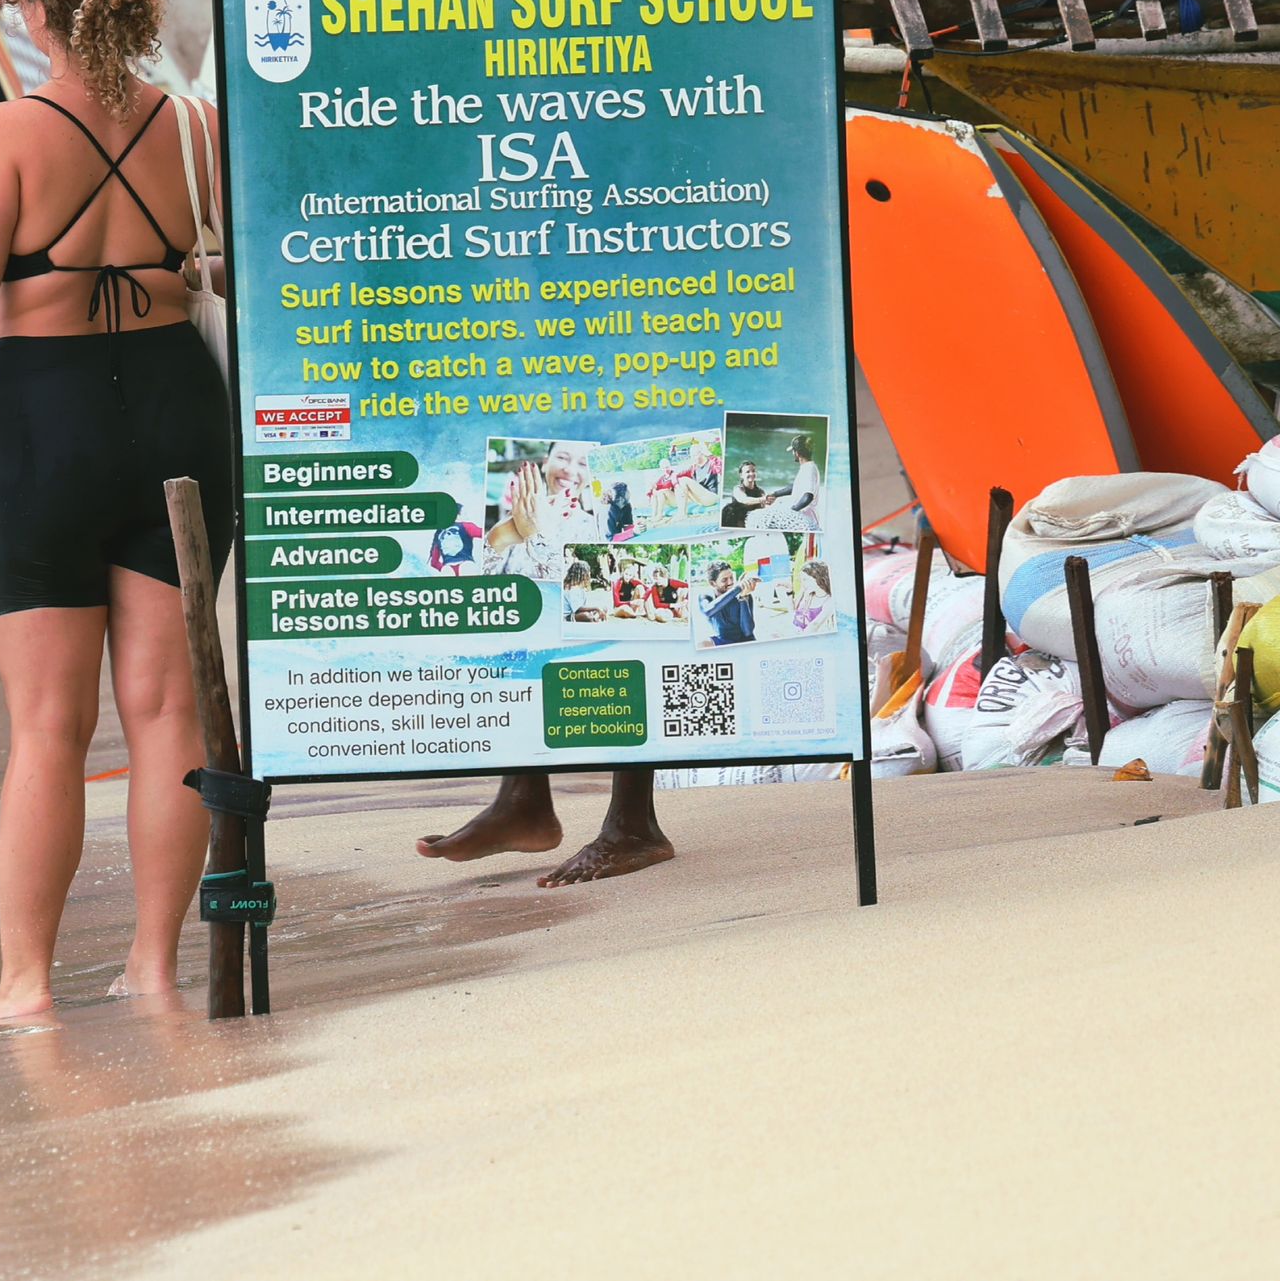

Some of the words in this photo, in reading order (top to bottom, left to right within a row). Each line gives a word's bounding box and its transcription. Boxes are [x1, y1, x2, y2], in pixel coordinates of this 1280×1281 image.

[261, 55, 298, 63] HIRIKETIYA
[484, 34, 652, 77] HIRIKETIYA
[298, 86, 397, 128] Ride
[410, 84, 483, 126] the
[496, 88, 646, 123] waves
[659, 74, 764, 117] with
[477, 130, 590, 183] ISA
[300, 185, 482, 221] (International
[490, 183, 593, 215] Surfing
[601, 177, 769, 207] Association)
[281, 223, 453, 264] Certified
[464, 220, 555, 259] Surf
[565, 218, 791, 255] Instructors
[281, 282, 341, 310] Surf
[350, 282, 463, 307] lessons
[470, 277, 530, 304] with
[540, 270, 717, 307] experienced
[727, 267, 795, 295] local
[295, 319, 352, 346] surf
[361, 317, 525, 344] instructors.
[534, 317, 576, 339] we
[584, 310, 633, 337] will
[641, 307, 721, 335] teach
[729, 310, 783, 338] you
[302, 357, 363, 383] how
[370, 357, 401, 382] to
[407, 352, 487, 380] catch
[495, 356, 513, 377] a
[521, 353, 604, 377] wave,
[614, 349, 716, 379] pop-up
[725, 342, 779, 369] and
[359, 390, 416, 418] ride
[423, 390, 470, 416] the
[478, 392, 552, 415] wave
[562, 386, 588, 412] in
[596, 387, 625, 411] to
[634, 384, 724, 410] shore.
[261, 412, 285, 422] WE
[288, 410, 342, 422] ACCEPT
[264, 462, 393, 487] Beginners
[266, 504, 425, 526] Intermediate
[270, 545, 379, 566] Advance
[271, 588, 359, 610] Private
[366, 587, 464, 607] lessons
[471, 582, 517, 604] and
[271, 612, 370, 632] lessons
[376, 609, 412, 629] for
[418, 607, 459, 628] the
[467, 605, 520, 626] kids
[288, 669, 303, 685] In
[309, 667, 381, 685] addition
[387, 669, 412, 682] we
[417, 665, 462, 681] tailor
[467, 662, 508, 684] your
[558, 667, 610, 680] Contact
[613, 668, 629, 678] us
[264, 693, 362, 714] experience
[368, 689, 464, 711] depending
[470, 691, 493, 704] on
[498, 686, 532, 703] surf
[561, 687, 575, 699] to
[579, 684, 615, 698] make
[618, 686, 627, 697] a
[287, 716, 384, 734] conditions,
[391, 714, 424, 731] skill
[430, 713, 470, 729] level
[476, 711, 510, 728] and
[559, 702, 631, 717] reservation
[547, 725, 561, 736] or
[565, 724, 587, 738] per
[590, 720, 644, 736] booking
[308, 739, 405, 758] convenient
[411, 737, 491, 754] locations
